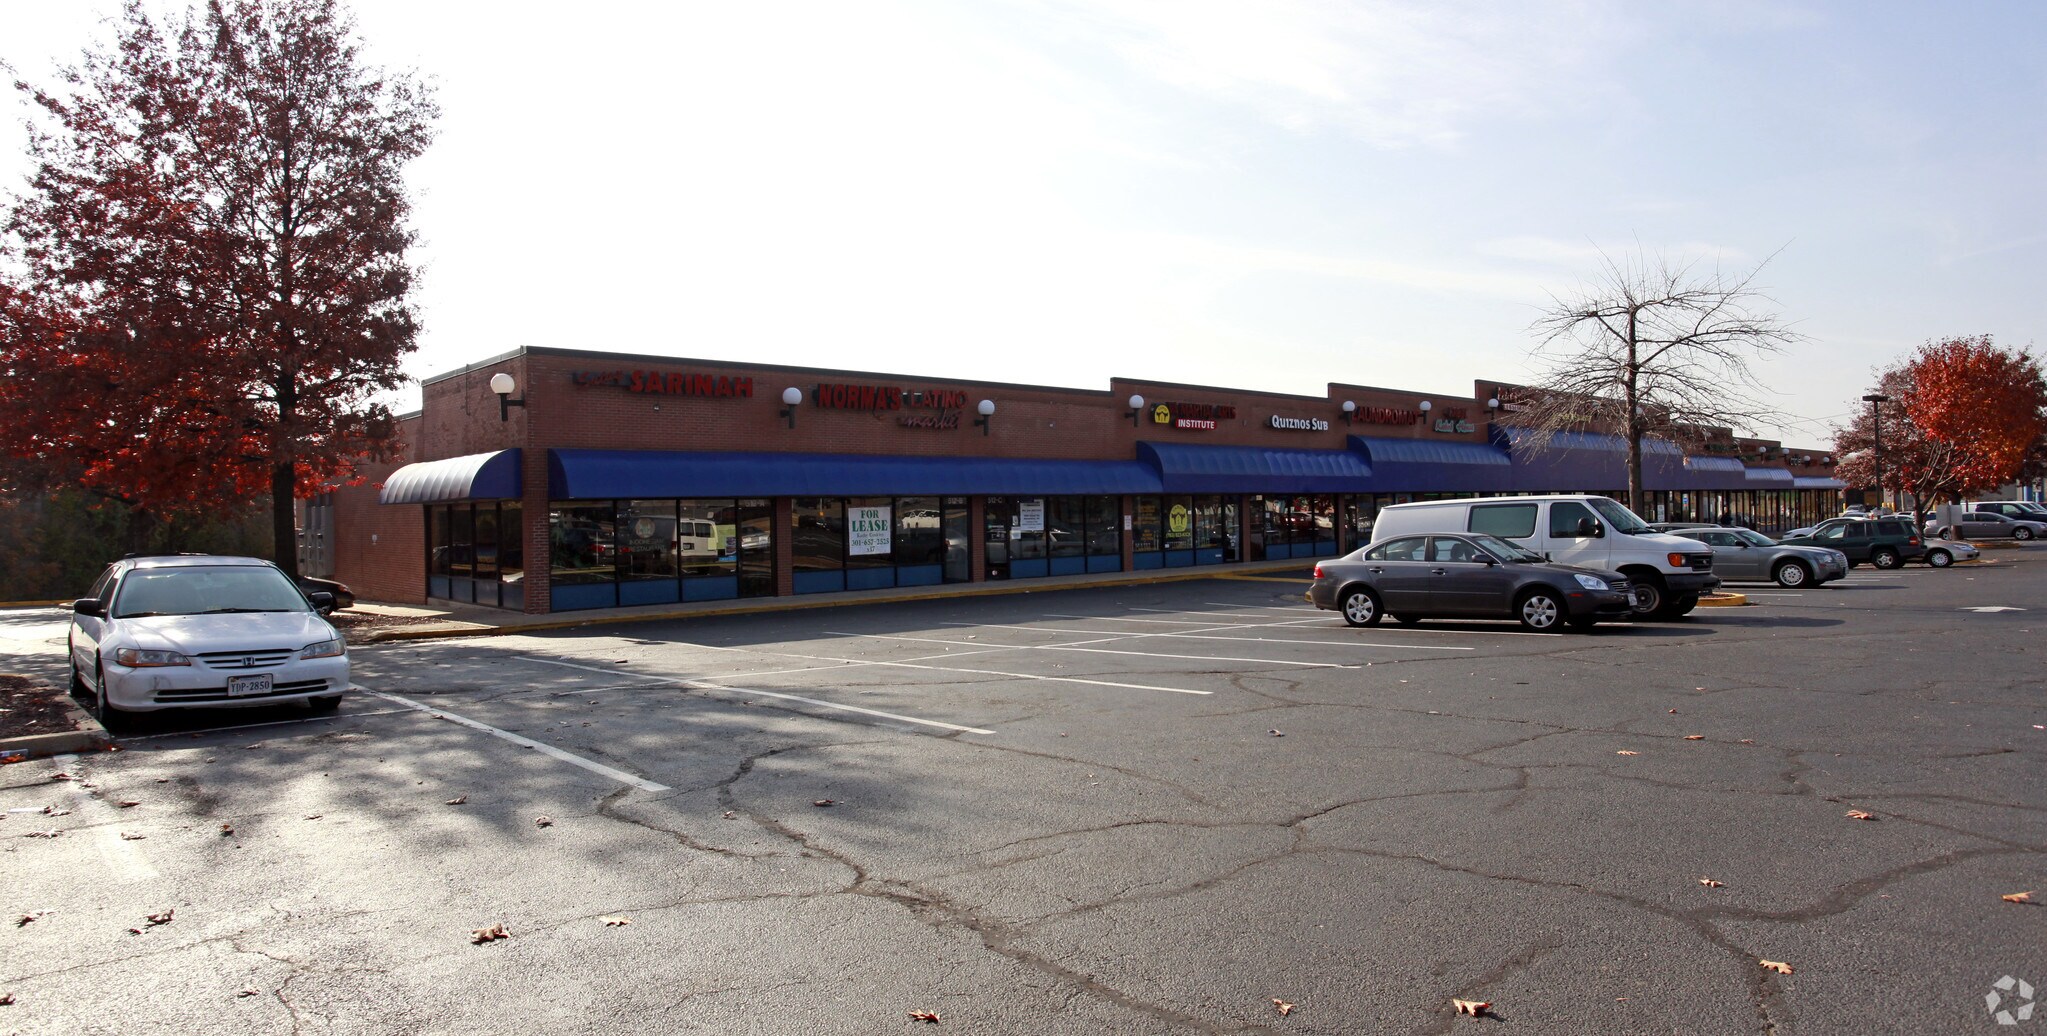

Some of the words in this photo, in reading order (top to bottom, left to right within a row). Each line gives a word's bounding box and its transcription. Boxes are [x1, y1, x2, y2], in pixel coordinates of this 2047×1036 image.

[630, 370, 753, 398] SARINAH
[818, 384, 901, 411] NORMA'S
[910, 389, 968, 409] LATINO
[1178, 419, 1215, 429] INSTITUTE
[861, 510, 879, 519] FOR
[852, 520, 888, 532] LEASE
[231, 681, 270, 692] YDP-2850
